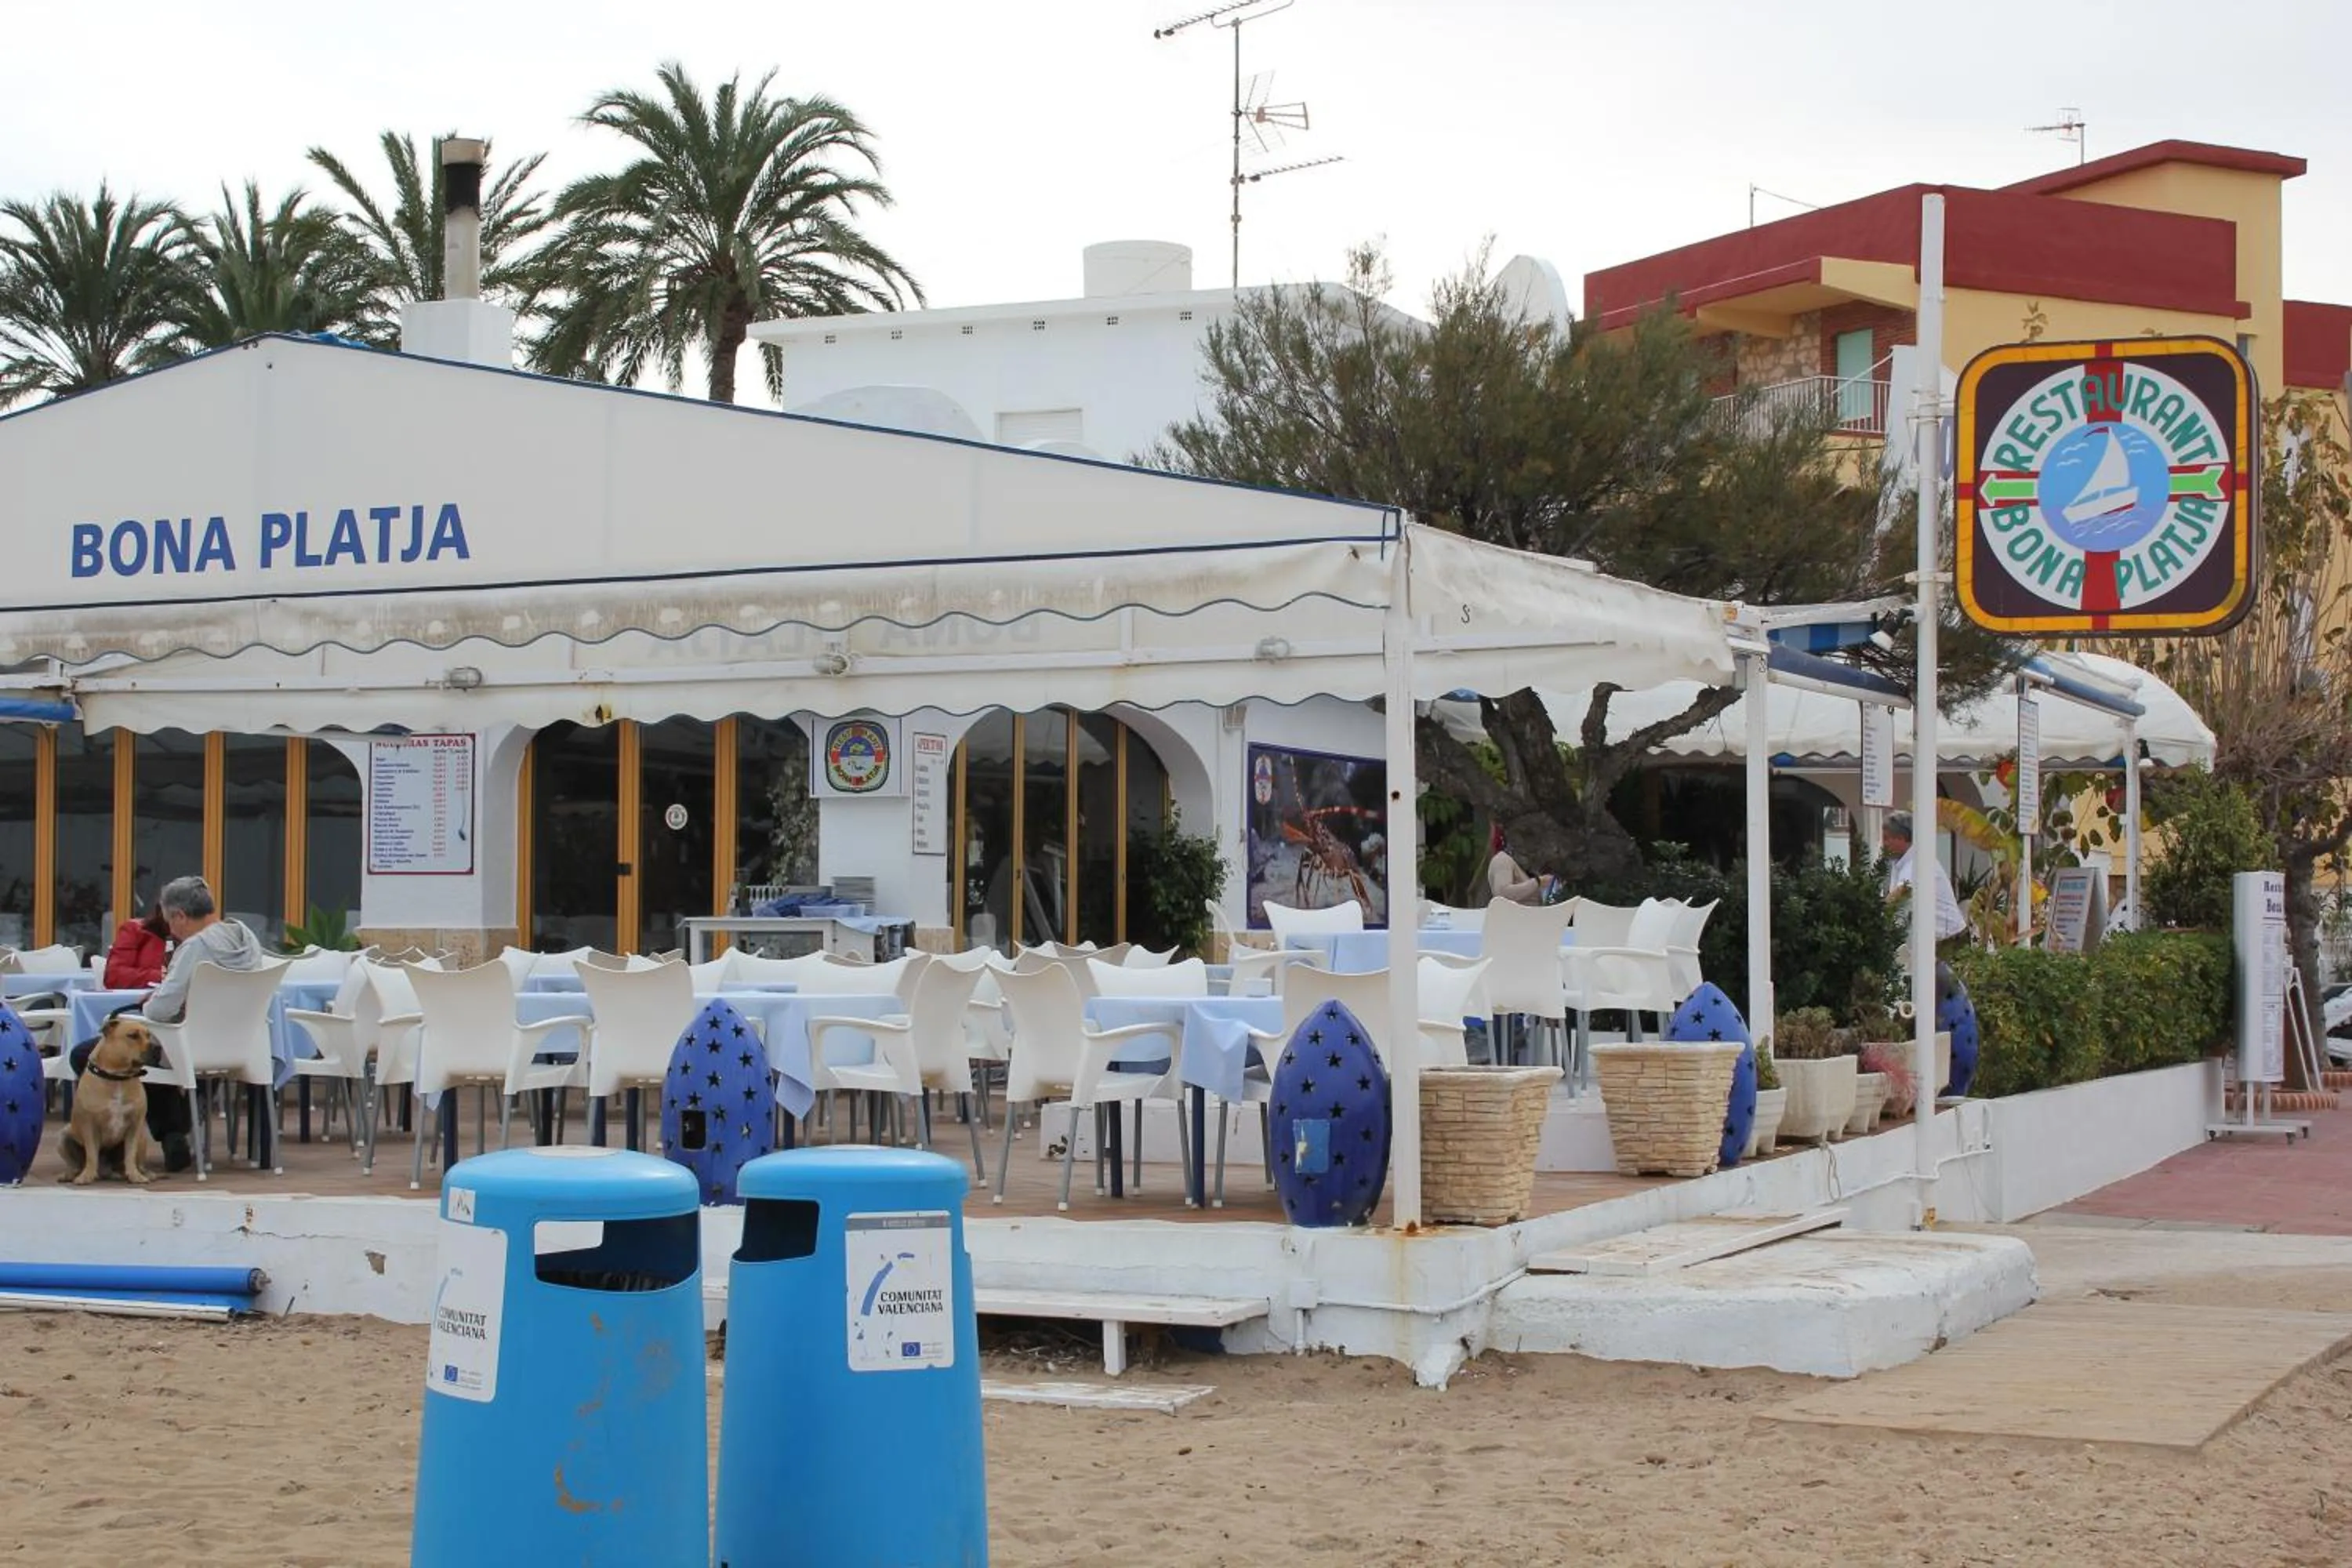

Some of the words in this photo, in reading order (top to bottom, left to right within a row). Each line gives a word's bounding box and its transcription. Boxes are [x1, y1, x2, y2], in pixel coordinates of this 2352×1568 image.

[1993, 373, 2217, 474] RESTAURANT
[71, 517, 236, 578] BONA
[260, 503, 470, 569] PLATJA
[1991, 502, 2086, 599] BONA
[2112, 496, 2218, 599] PLATJA
[432, 738, 467, 748] TAPAS
[880, 1290, 943, 1302] COMUNITAT
[438, 1305, 487, 1327] COMUNITAT
[877, 1302, 944, 1315] VALENCIANA
[437, 1318, 487, 1340] VALENCIANA
